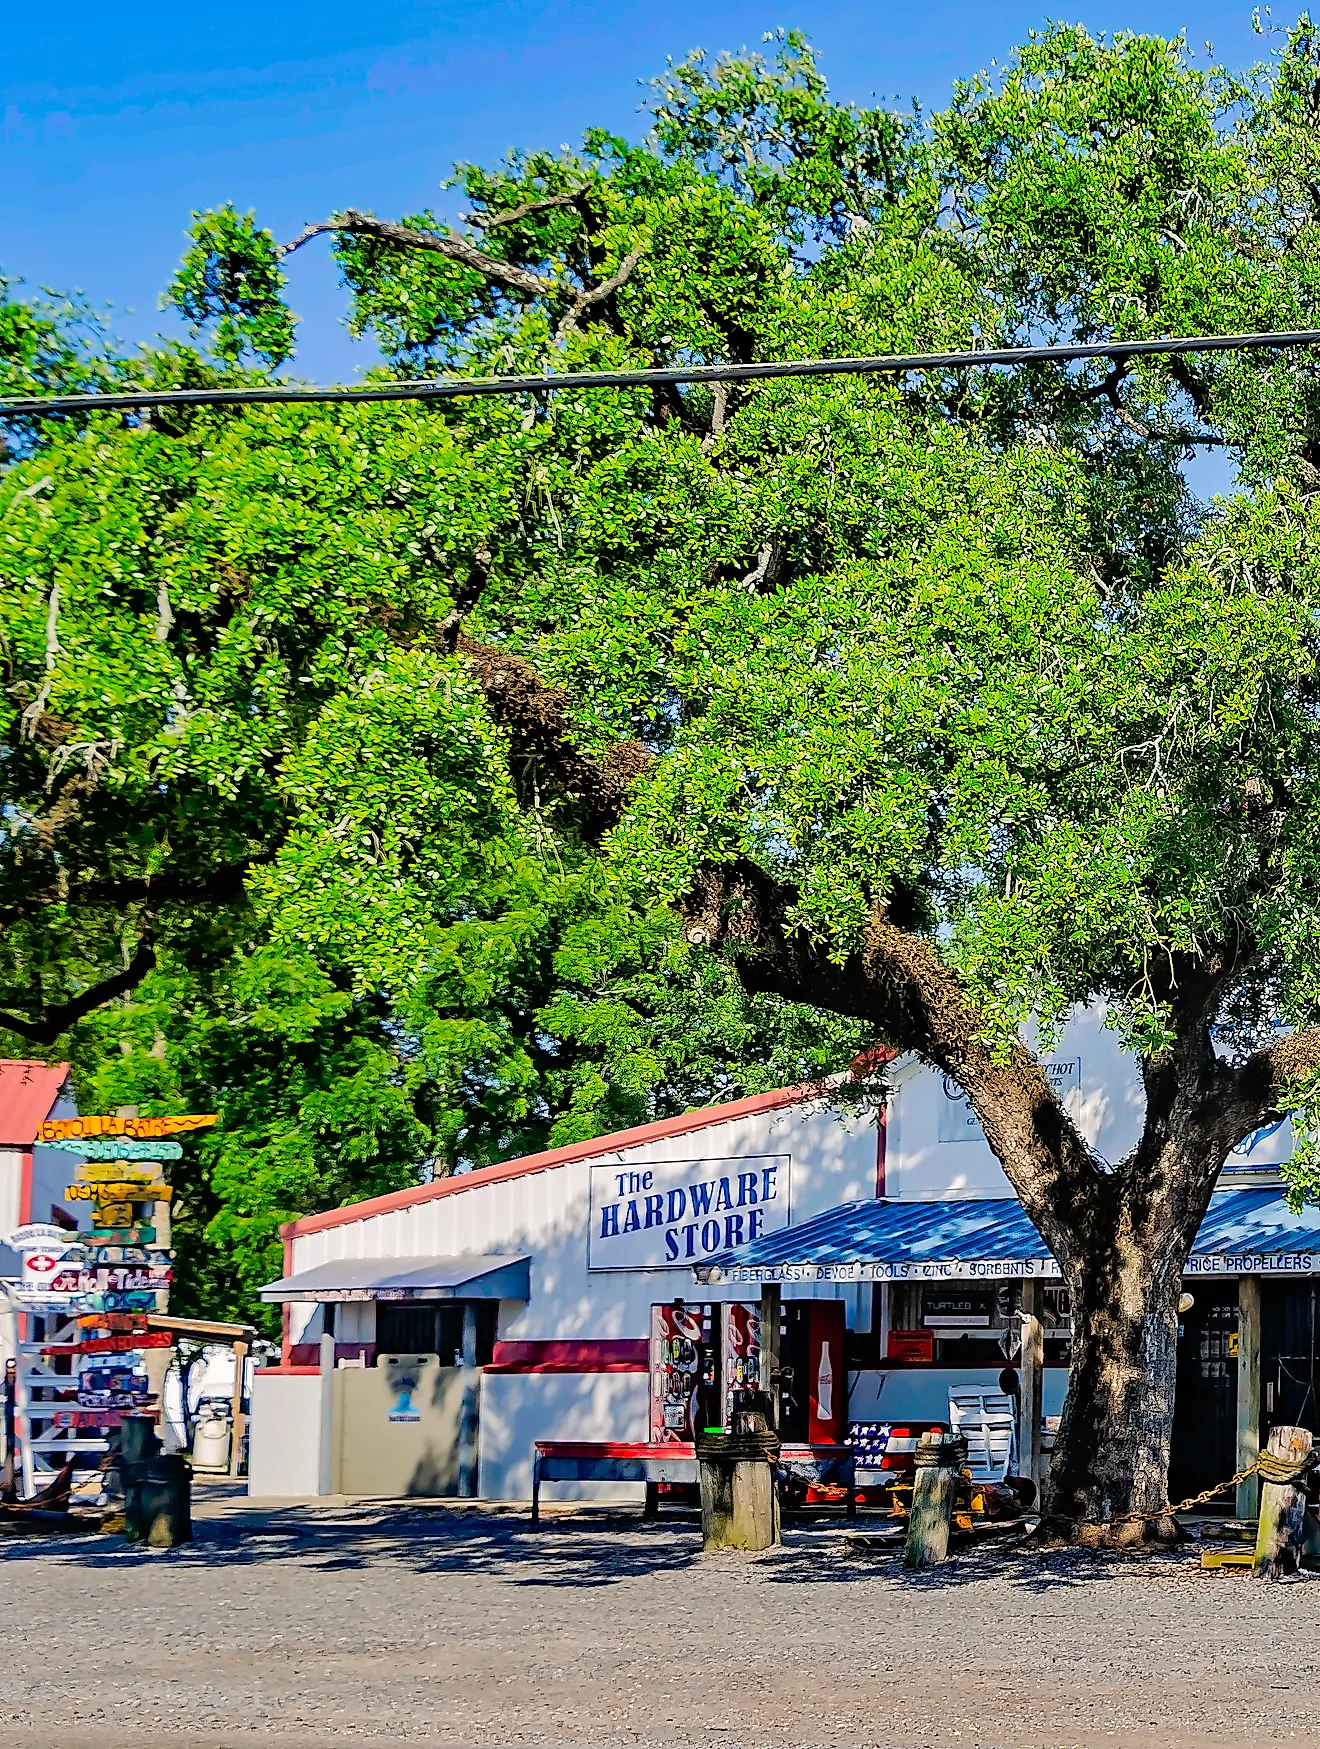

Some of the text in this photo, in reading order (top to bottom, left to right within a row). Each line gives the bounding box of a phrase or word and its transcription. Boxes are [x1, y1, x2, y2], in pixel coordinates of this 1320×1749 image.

[600, 1166, 778, 1239] HARDWARE
[615, 1170, 653, 1197] The
[665, 1208, 765, 1262] STORE
[732, 1266, 801, 1281] FIBERGLASS
[816, 1265, 854, 1279] DEVOE
[871, 1264, 908, 1278] TOOLS
[924, 1264, 952, 1277] ZINC
[969, 1261, 1034, 1276] SORBENTS
[1190, 1257, 1220, 1272] RICE
[1226, 1255, 1312, 1271] PROPELLERS
